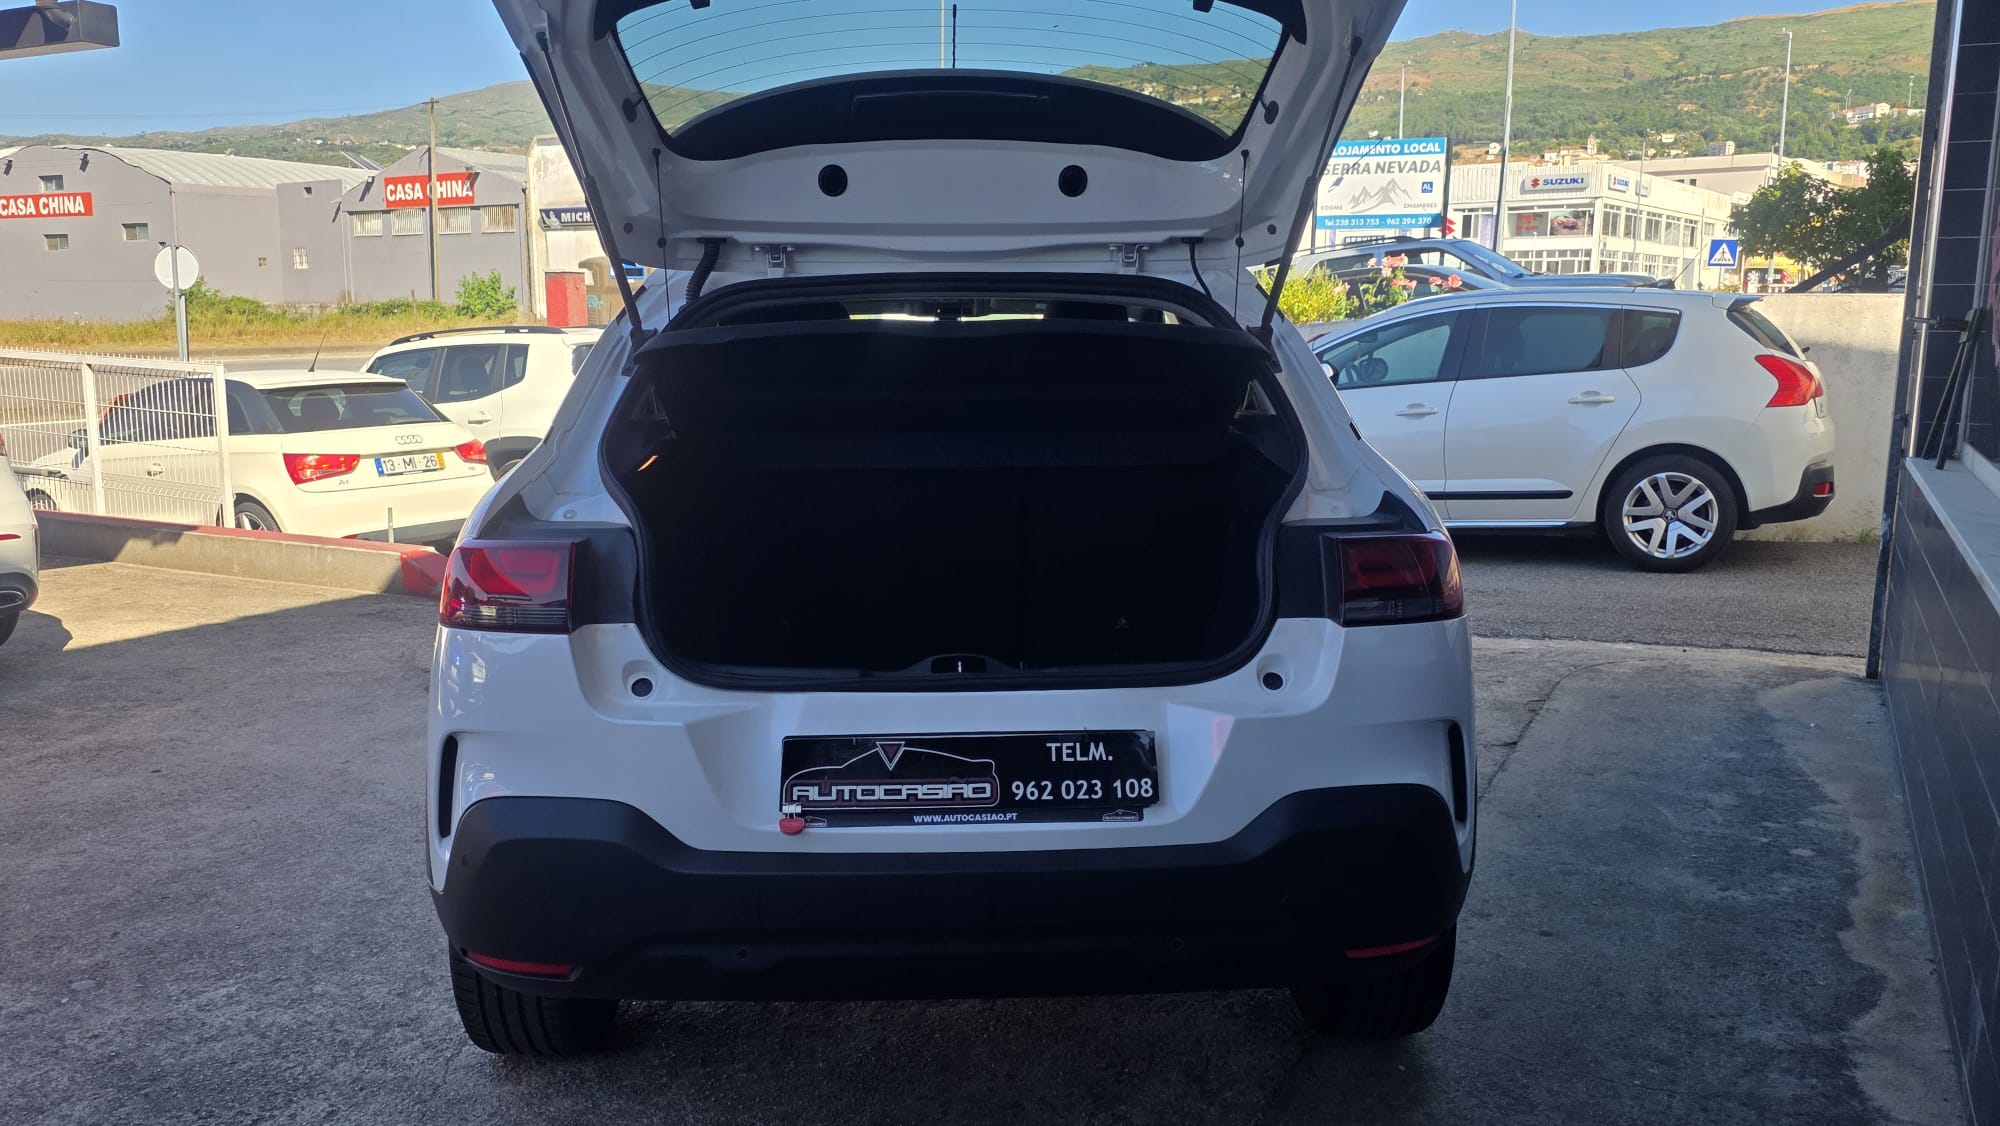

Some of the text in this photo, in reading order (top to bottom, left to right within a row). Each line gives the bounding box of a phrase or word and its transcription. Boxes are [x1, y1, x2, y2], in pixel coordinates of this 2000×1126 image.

[1331, 142, 1441, 156] LOJAMENTO LOCAL
[1374, 160, 1441, 174] NEVADA
[1542, 177, 1584, 186] SUZUKI
[386, 182, 424, 201] CASA
[0, 195, 86, 216] CASA CHINA
[1046, 742, 1113, 762] TELM.
[1011, 778, 1154, 800] 962 023 108
[913, 813, 1018, 823] WWW.AUTOCASIAO.PT
